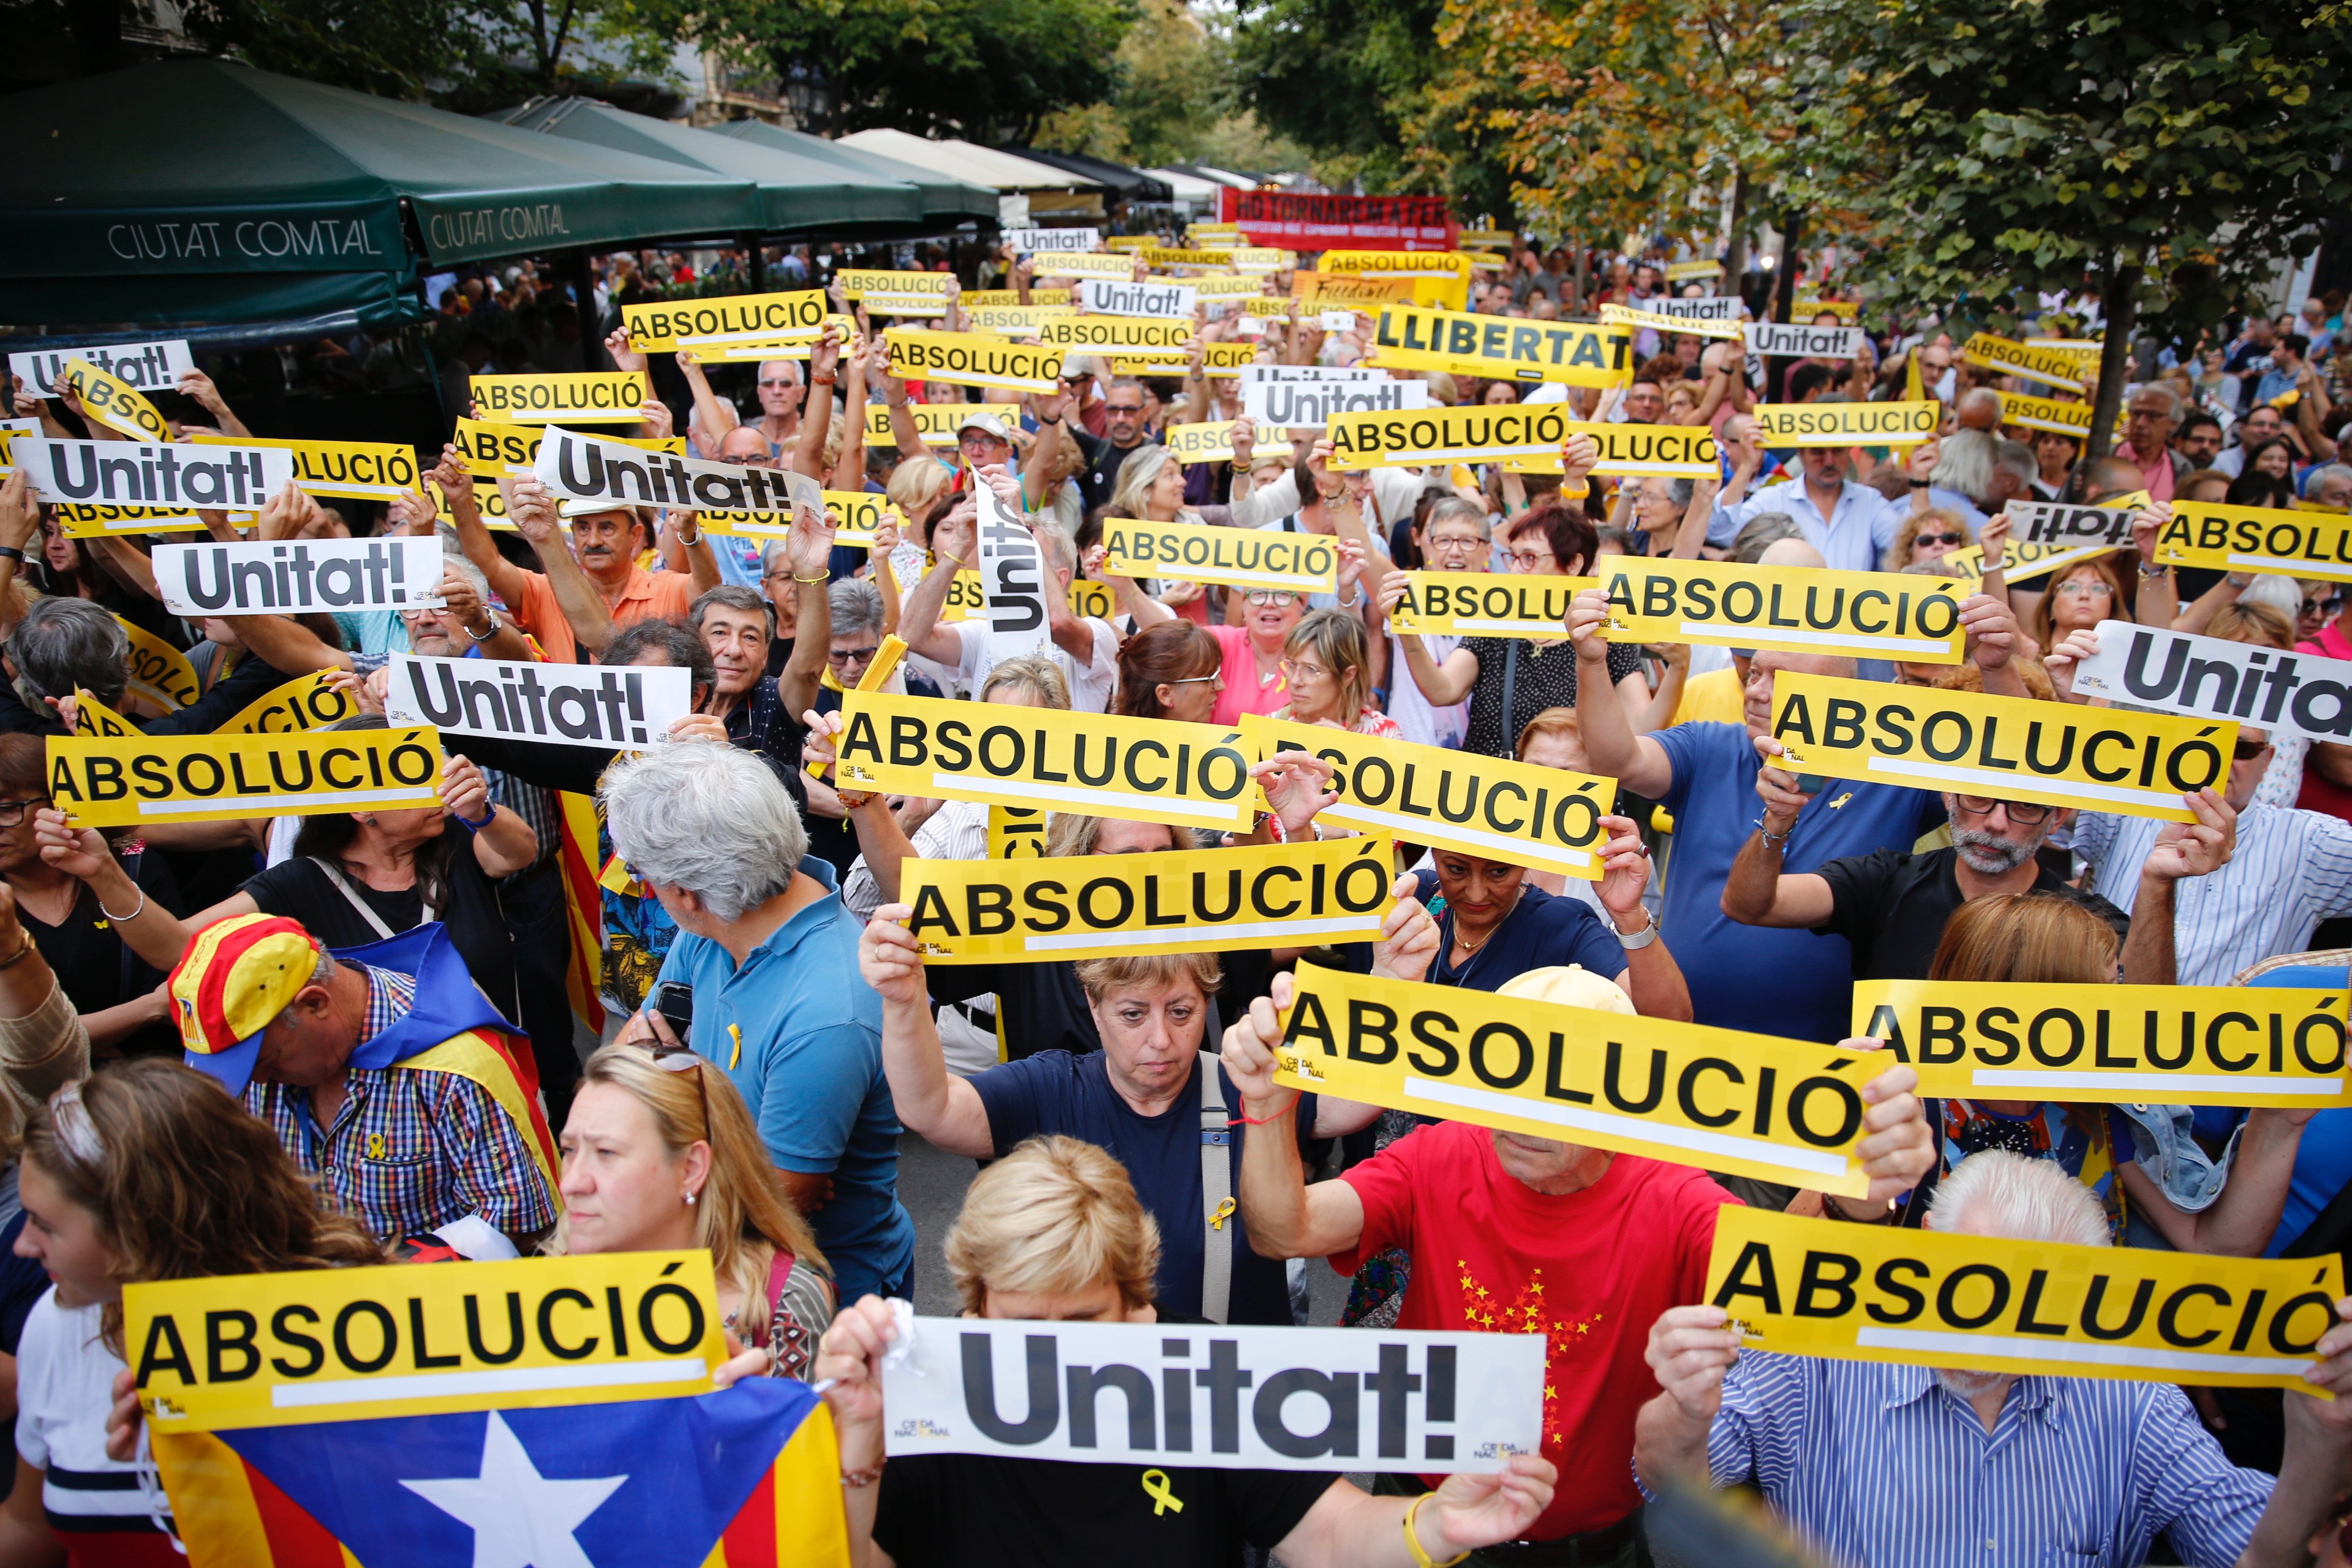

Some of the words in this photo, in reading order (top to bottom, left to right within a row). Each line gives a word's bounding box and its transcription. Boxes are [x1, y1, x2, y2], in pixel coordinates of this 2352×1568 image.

[431, 209, 493, 249] CIUTAT
[500, 204, 570, 242] COMTAL
[1237, 193, 1263, 219] HO
[1270, 194, 1382, 223] TORNAREM
[1390, 200, 1403, 222] A
[1409, 202, 1446, 225] FER
[108, 222, 221, 260] CIUTAT
[236, 219, 382, 257] COMTAL
[1023, 230, 1088, 250] Unitat!
[1331, 254, 1460, 271] ABSOLUCIÓ
[842, 273, 949, 293] ABSOLUCIÓ
[1036, 255, 1132, 273] ABSOLUCIÓ
[630, 293, 823, 341] ABSOLUCIÓ
[981, 293, 1068, 306] ABSOUCIÓ
[1095, 282, 1180, 315] Unitat!
[1604, 304, 1743, 334] ABSOLUCIÓ
[1657, 299, 1728, 320] Unitat!
[1041, 318, 1190, 346] ABSOLUCIÓ
[1378, 311, 1630, 371] LLIBERTAT
[1755, 326, 1849, 355] Unitat!
[32, 345, 172, 394] Uitat!
[889, 341, 1061, 381] ABSOLUCIÓ
[1967, 333, 2091, 385] ABSOLUCIÓ
[473, 375, 643, 410] ABSOLUCIÓ
[1332, 405, 1564, 452] ABSOLUCIÓ
[1760, 404, 1934, 435] ABSOLUCIÓ
[1586, 424, 1717, 464] OLUCIÓ
[50, 443, 266, 506] Unitat!
[559, 435, 792, 510] Unitat!
[1107, 529, 1332, 575] ABSOLUCIÓ
[184, 543, 407, 609] Unitat!
[1393, 584, 1572, 620] ABSOLU
[1607, 573, 1960, 639] ABSOLUCIÓ
[406, 661, 648, 744] Unitat!
[50, 731, 435, 802] ABSOLUCIÓ
[840, 711, 1248, 801] ABSOLUCIÓ
[1774, 693, 2222, 793] ABSOLUCIÓ
[1259, 739, 1601, 847] SOLUCIÓ
[911, 841, 1389, 938] ABSOLUCIÓ
[1864, 997, 2347, 1075] ABSOLUCIÓ
[1282, 992, 1862, 1149] ABSOLUCIÓ
[1713, 1241, 2341, 1355] ABSOLUCIÓ
[135, 1262, 707, 1389] ABSOLUCIÓ
[959, 1332, 1457, 1461] Unitat!
